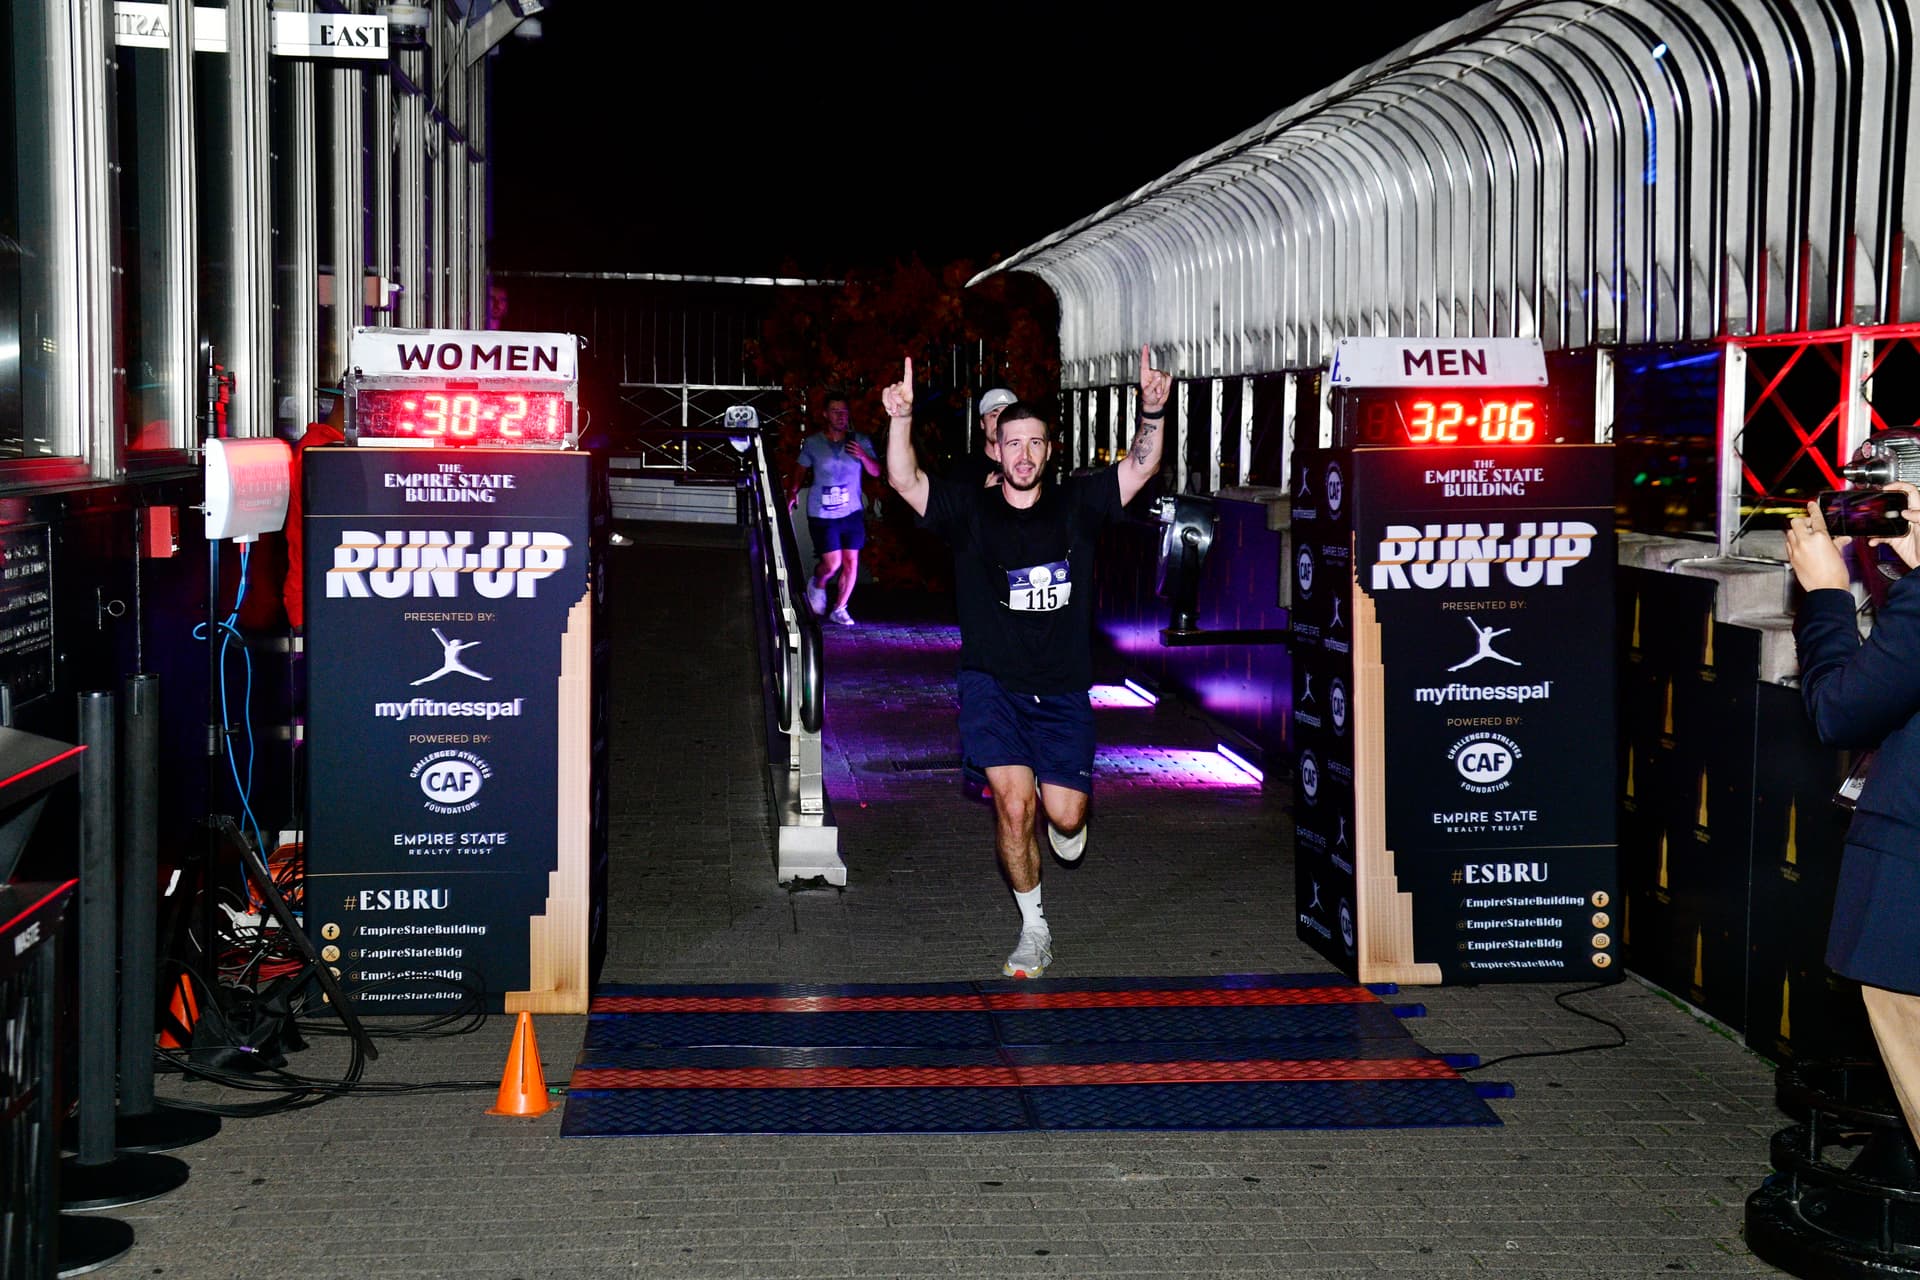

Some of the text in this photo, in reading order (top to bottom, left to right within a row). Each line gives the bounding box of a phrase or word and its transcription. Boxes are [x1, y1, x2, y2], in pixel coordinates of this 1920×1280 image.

[320, 25, 385, 48] EAST
[397, 343, 558, 371] WOMEN
[1403, 348, 1487, 376] MEN
[438, 463, 462, 473] THE
[1473, 459, 1495, 469] THE
[384, 473, 516, 489] EMPIRE STATE
[1425, 468, 1544, 484] EMPIRE STATE
[405, 488, 496, 503] BUILDING
[1444, 482, 1525, 498] BUILDING
[326, 530, 573, 598] RUN-UP
[1372, 521, 1598, 590] RUN-UP
[1025, 586, 1058, 610] 115
[1442, 600, 1527, 610] PRESENTED BY:
[404, 612, 496, 622] PRESENTED BY:
[1415, 681, 1550, 705] myfitnesspal
[375, 698, 523, 721] myfitnesspal
[1447, 717, 1523, 727] POWERED BY:
[409, 734, 491, 744] POWERED BY:
[1447, 732, 1523, 760] CHALLENGED ATHLETES
[409, 750, 493, 779] CHALLENGED ATHLETES
[1462, 752, 1506, 772] CAF
[426, 771, 473, 792] CAF
[1433, 810, 1538, 824] EMPIRE STATE
[394, 832, 508, 846] EMPIRE STATE
[1451, 862, 1548, 884] #ESBRU
[343, 888, 449, 911] #ESBRU
[1456, 918, 1563, 930] @EmpireStateBldg
[1457, 938, 1563, 950] @EmpireStateBldg
